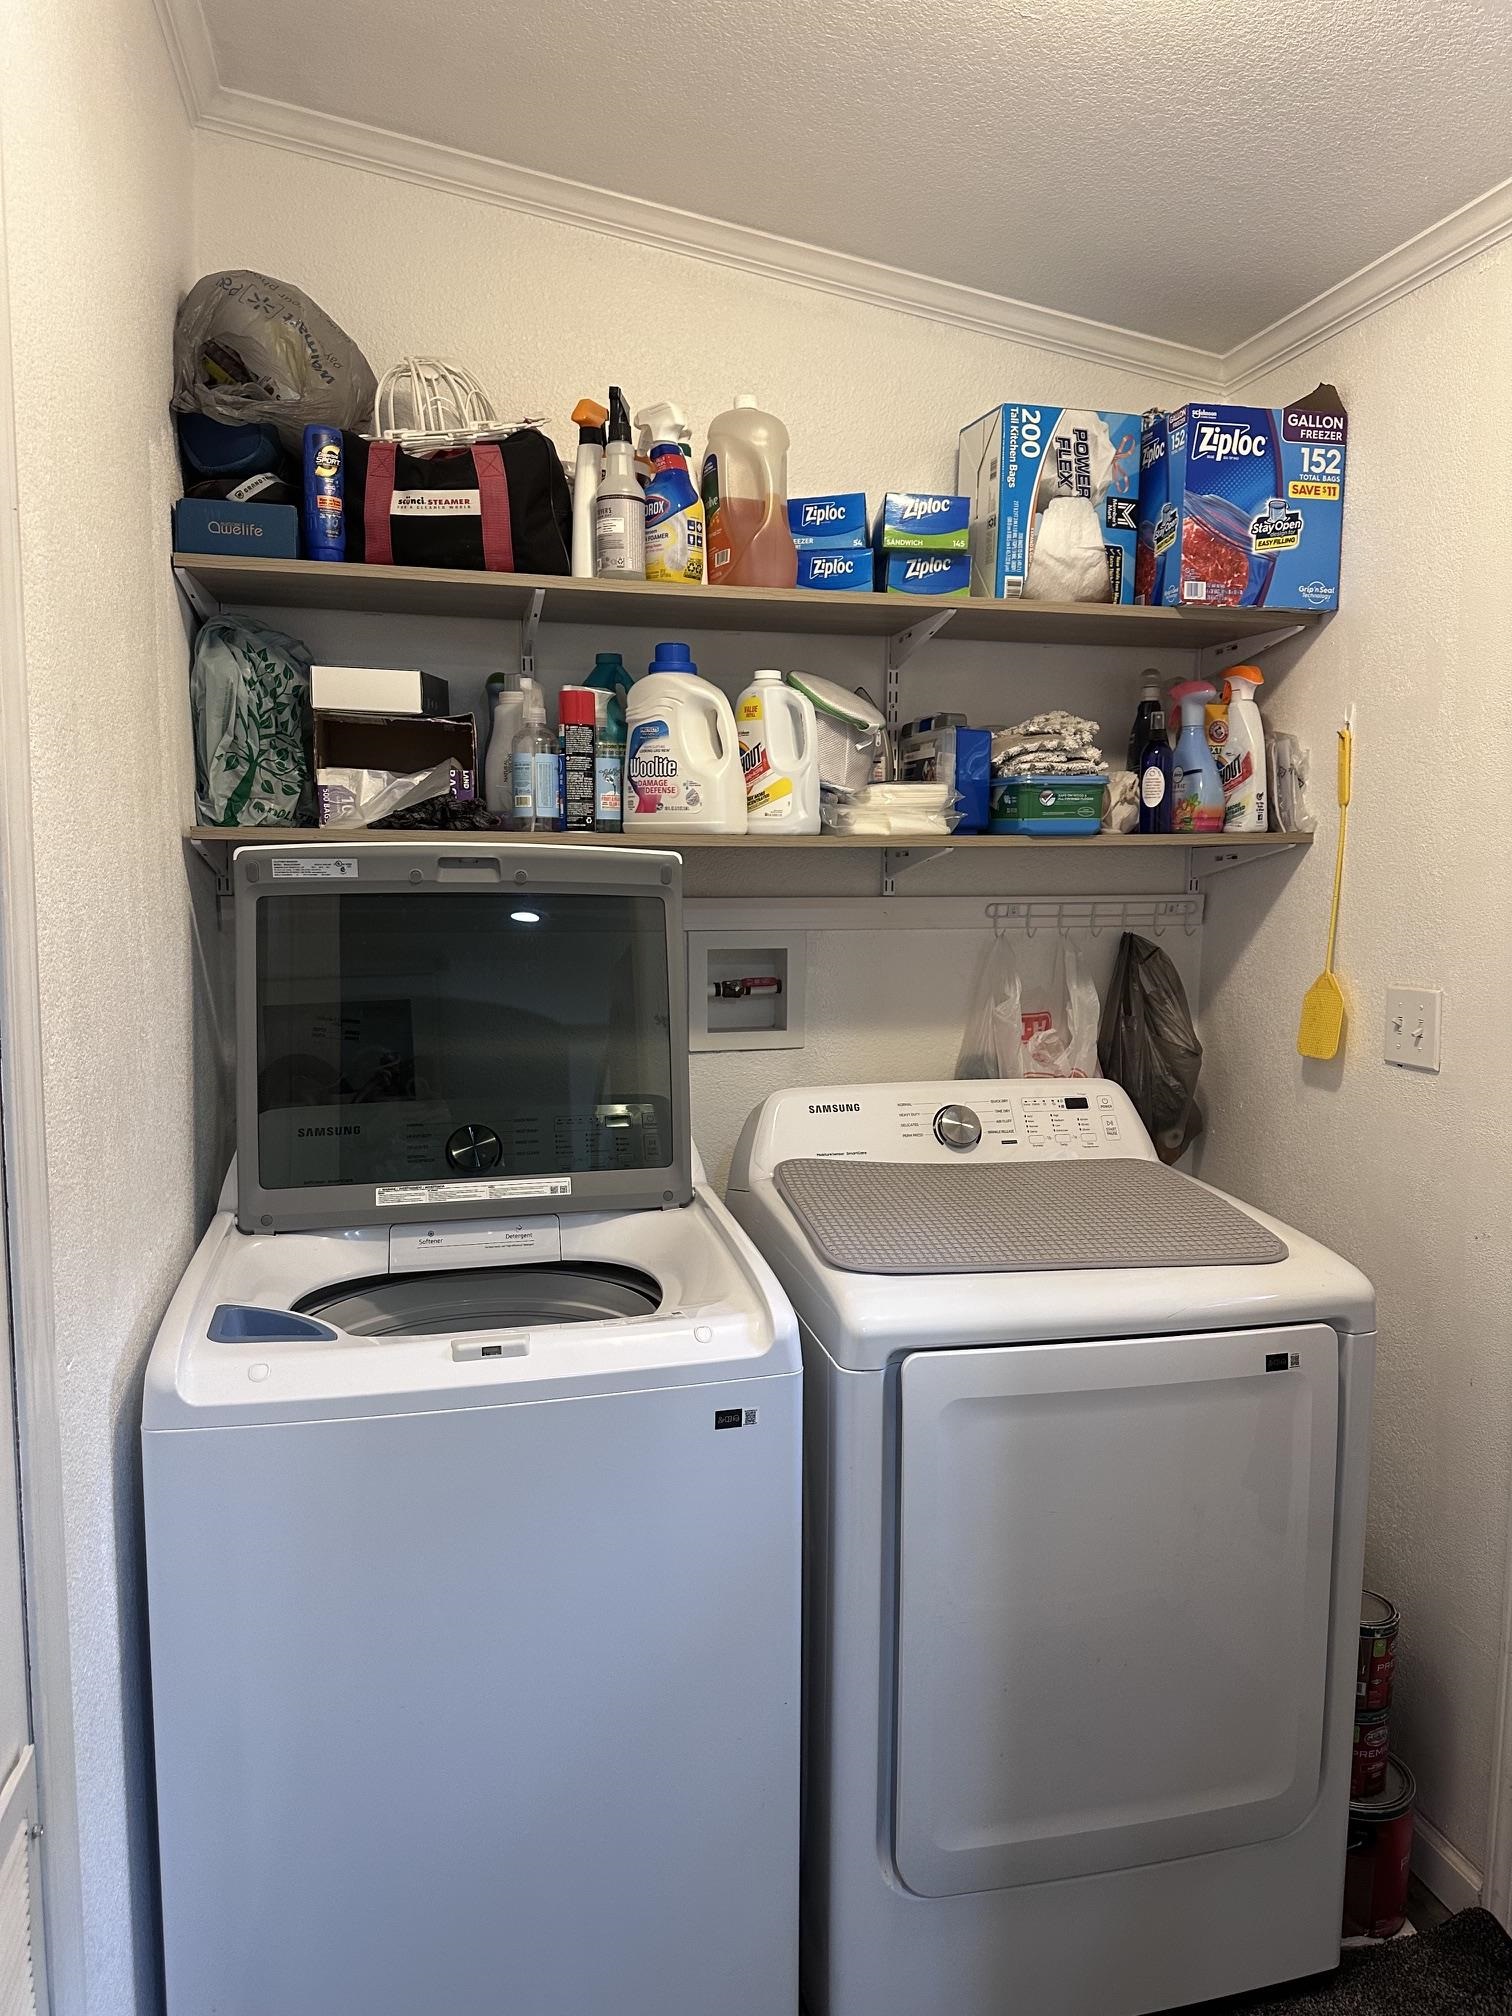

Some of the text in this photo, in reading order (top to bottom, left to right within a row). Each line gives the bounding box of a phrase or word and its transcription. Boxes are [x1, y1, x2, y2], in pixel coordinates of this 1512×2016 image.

[282, 312, 335, 385] Walmart
[1288, 413, 1344, 430] GALLON
[1021, 408, 1041, 459] 200
[1171, 429, 1186, 451] 152
[1300, 429, 1342, 441] FREEZER
[1008, 407, 1019, 488] Tall Kitchen Bags
[1199, 426, 1266, 462] Ziploc
[315, 456, 341, 466] SPORT
[1055, 436, 1074, 490] FLEX
[1073, 428, 1091, 499] POWER
[1301, 447, 1341, 475] 152
[1299, 474, 1320, 482] TOTAL
[1292, 484, 1337, 497] SAVE $11
[805, 505, 846, 526] Ziploc
[903, 497, 951, 521] Ziploc
[853, 539, 863, 547] 54
[952, 540, 966, 548] 145
[1258, 537, 1296, 548] EASY FILLING
[813, 559, 854, 579] Ziploc
[905, 557, 951, 580] Ziploc
[1302, 592, 1331, 600] Technology
[1319, 586, 1335, 594] Seal
[743, 705, 758, 713] VALUE
[740, 742, 762, 774] HOUT
[629, 756, 678, 778] Woolite
[1220, 753, 1242, 785] HOUT
[638, 779, 668, 787] DAMAGE
[322, 789, 330, 802] 500
[808, 1103, 860, 1114] SAMSUNG
[297, 1125, 361, 1138] SAMSUNG
[418, 1237, 443, 1246] Softener
[505, 1231, 533, 1241] Detergent
